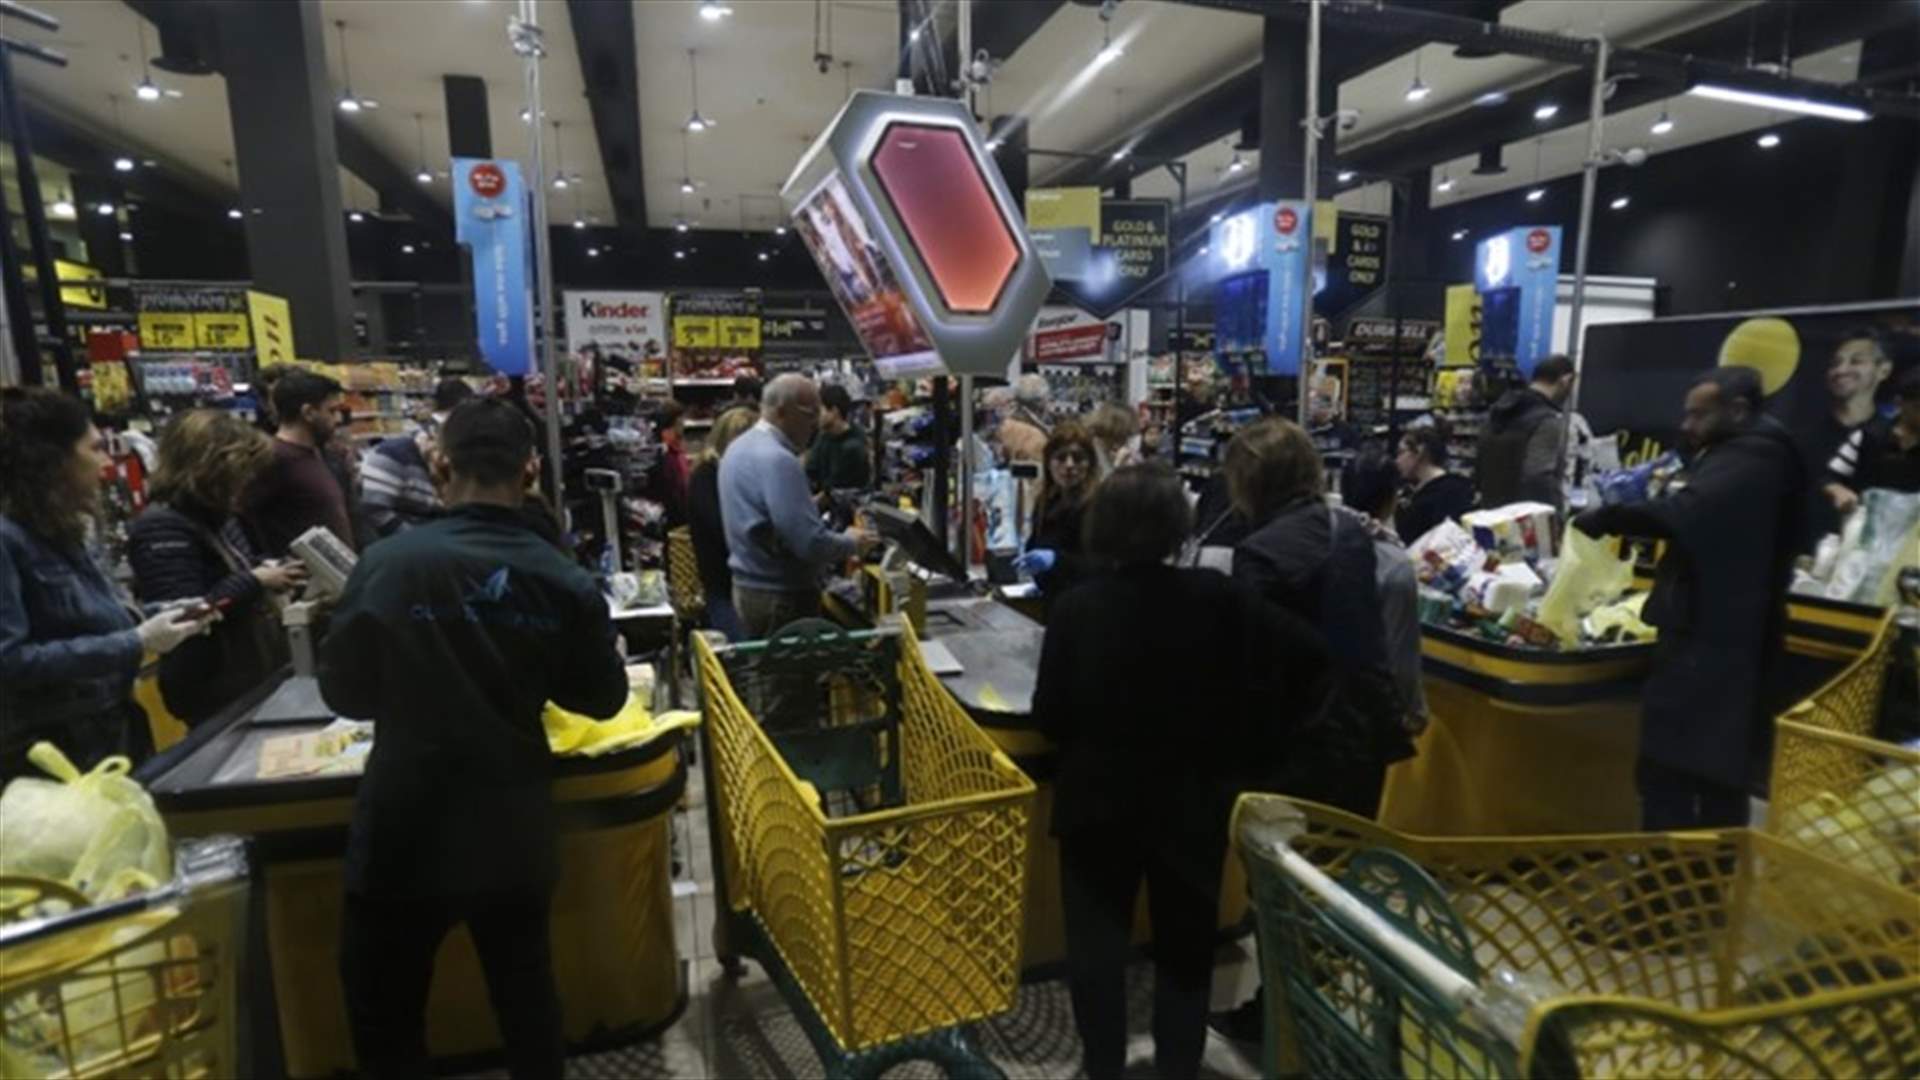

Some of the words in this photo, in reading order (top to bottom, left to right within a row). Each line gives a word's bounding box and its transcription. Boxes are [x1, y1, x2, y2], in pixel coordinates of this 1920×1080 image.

[1112, 220, 1142, 233] GOLD
[1145, 220, 1156, 233] &
[1350, 223, 1380, 238] GOLD
[1102, 233, 1168, 247] PLATINUM
[1114, 249, 1153, 262] CARDS
[1346, 254, 1380, 269] CARDS
[1118, 264, 1149, 278] ONLY
[1349, 269, 1376, 284] ONLY
